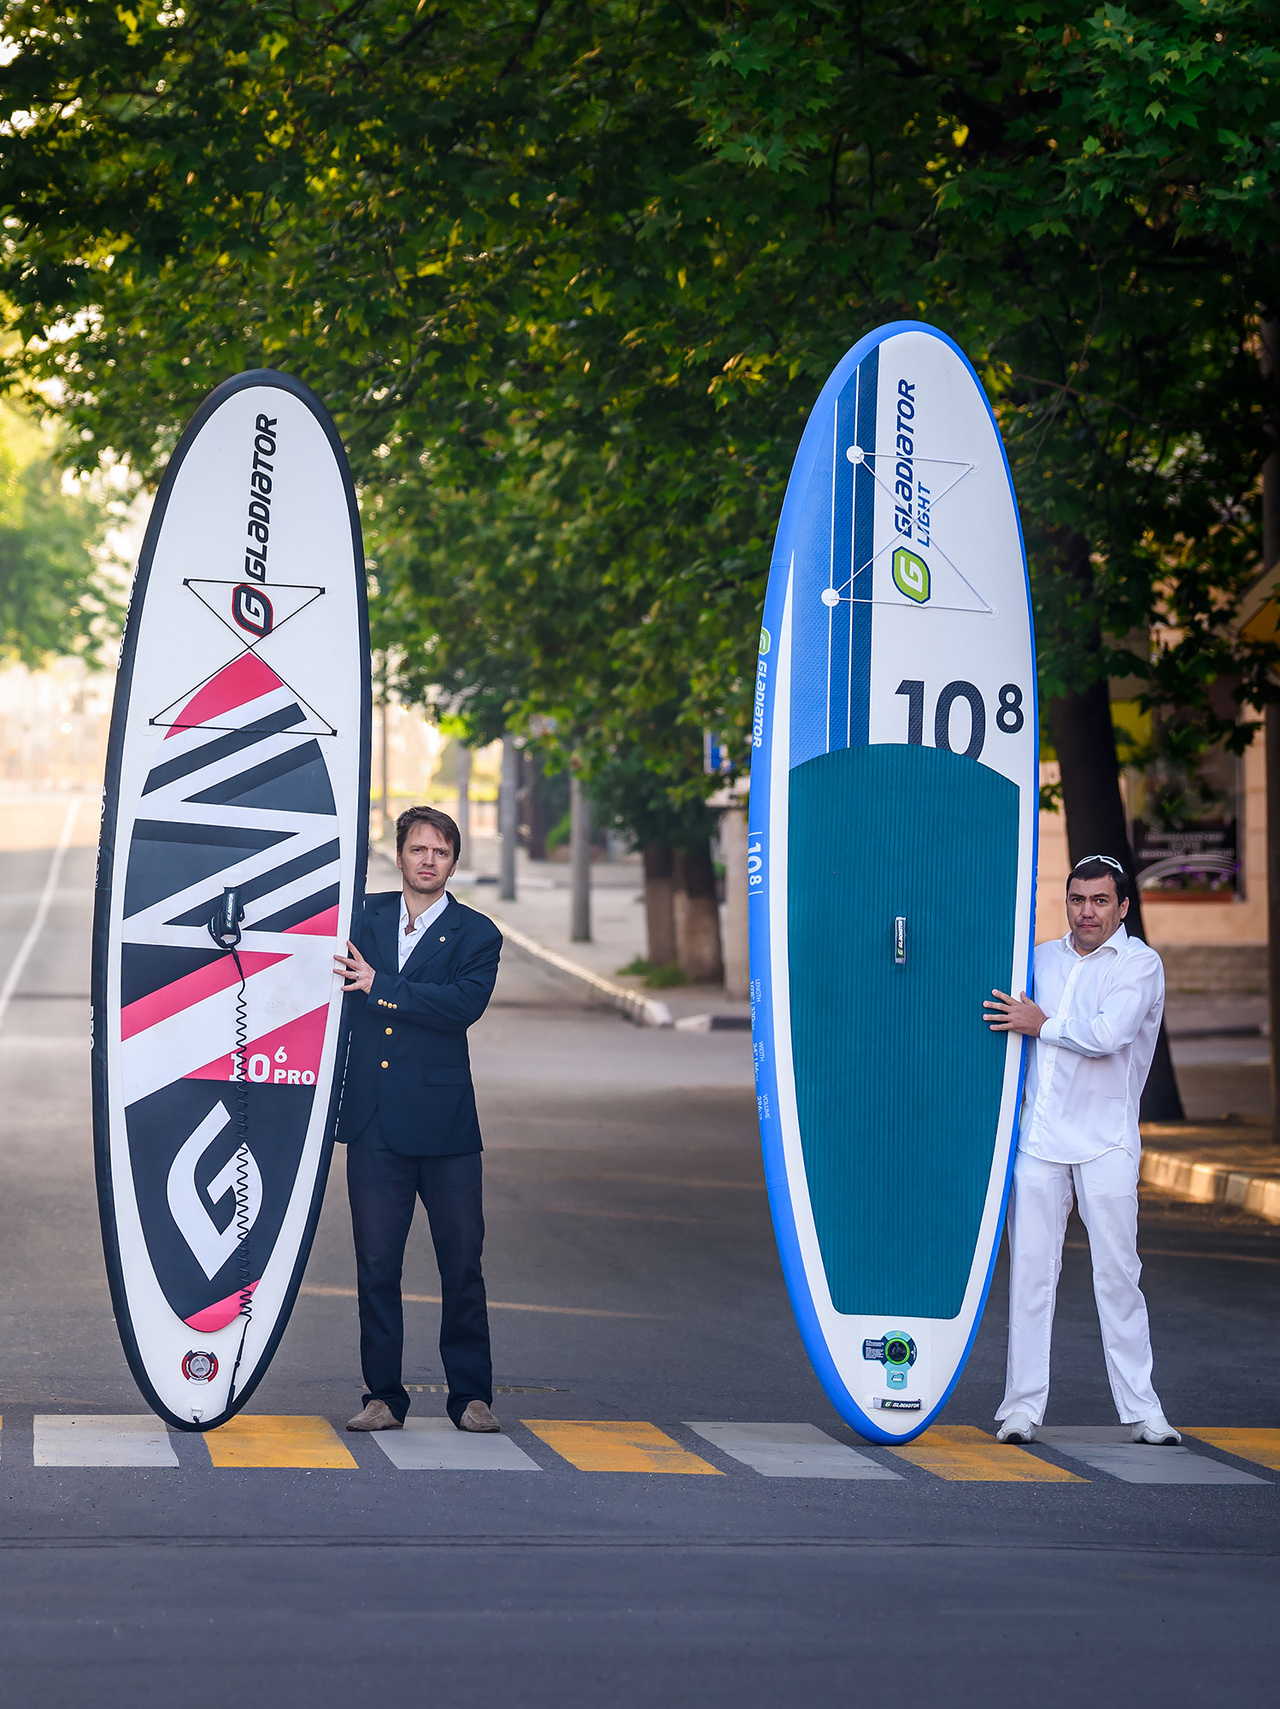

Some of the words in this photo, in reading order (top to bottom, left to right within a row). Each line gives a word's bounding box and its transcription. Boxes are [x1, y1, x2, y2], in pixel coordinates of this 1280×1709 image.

[917, 480, 931, 548] LIGHT
[754, 979, 762, 1002] LENGTH
[758, 1041, 766, 1062] WIDTH
[273, 1068, 316, 1085] PRO
[763, 1093, 771, 1119] VOLUME
